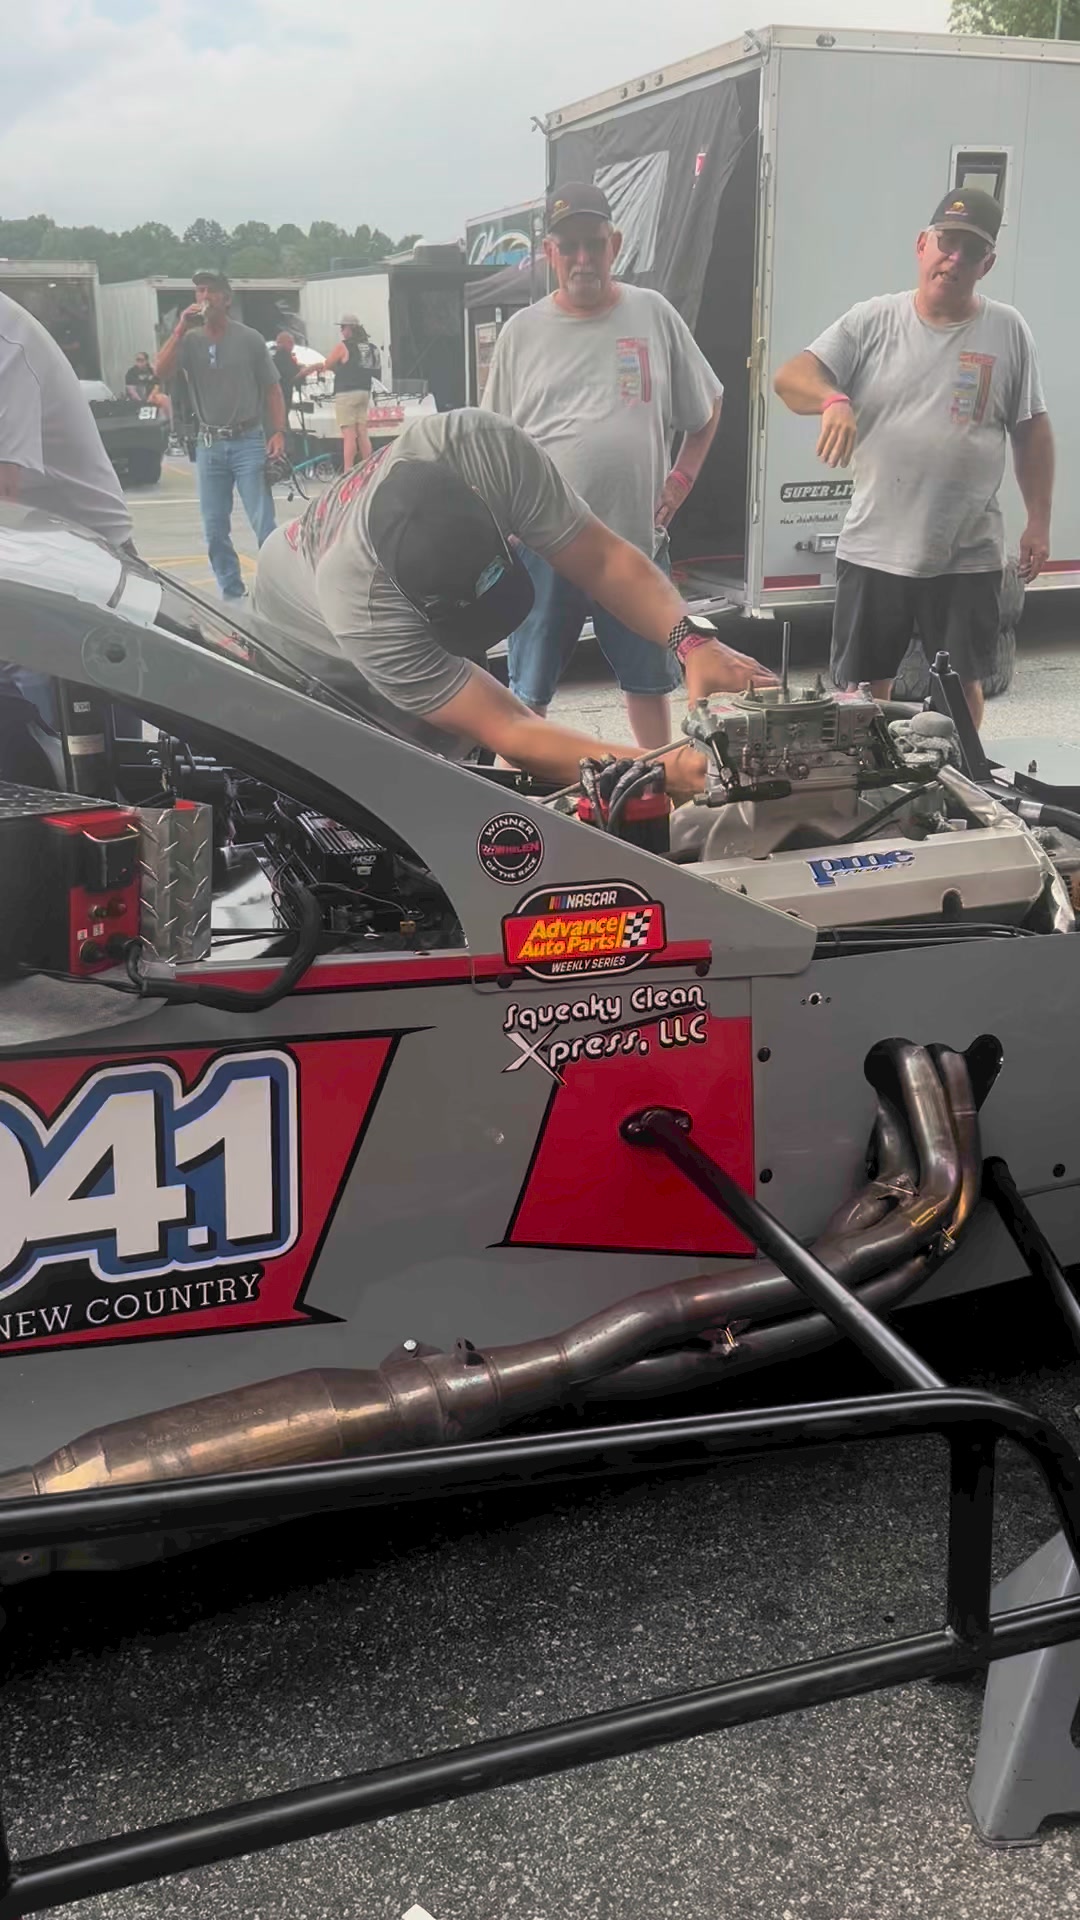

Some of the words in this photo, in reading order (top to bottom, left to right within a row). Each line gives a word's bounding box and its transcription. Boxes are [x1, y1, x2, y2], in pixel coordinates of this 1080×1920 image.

[485, 818, 534, 836] WINNER
[352, 855, 377, 864] MSD
[486, 860, 497, 871] OF
[499, 870, 517, 879] THE
[518, 857, 538, 877] RACE
[566, 890, 618, 909] NASCAR
[527, 916, 619, 941] Advance
[516, 938, 566, 960] Auto
[566, 933, 616, 956] Parts
[551, 959, 591, 974] WEEKLY
[591, 955, 626, 967] SERIES
[503, 993, 622, 1031] Squeaky
[631, 984, 707, 1010] Clean
[659, 1014, 707, 1044] LLC
[86, 1272, 260, 1325] COUNTRY
